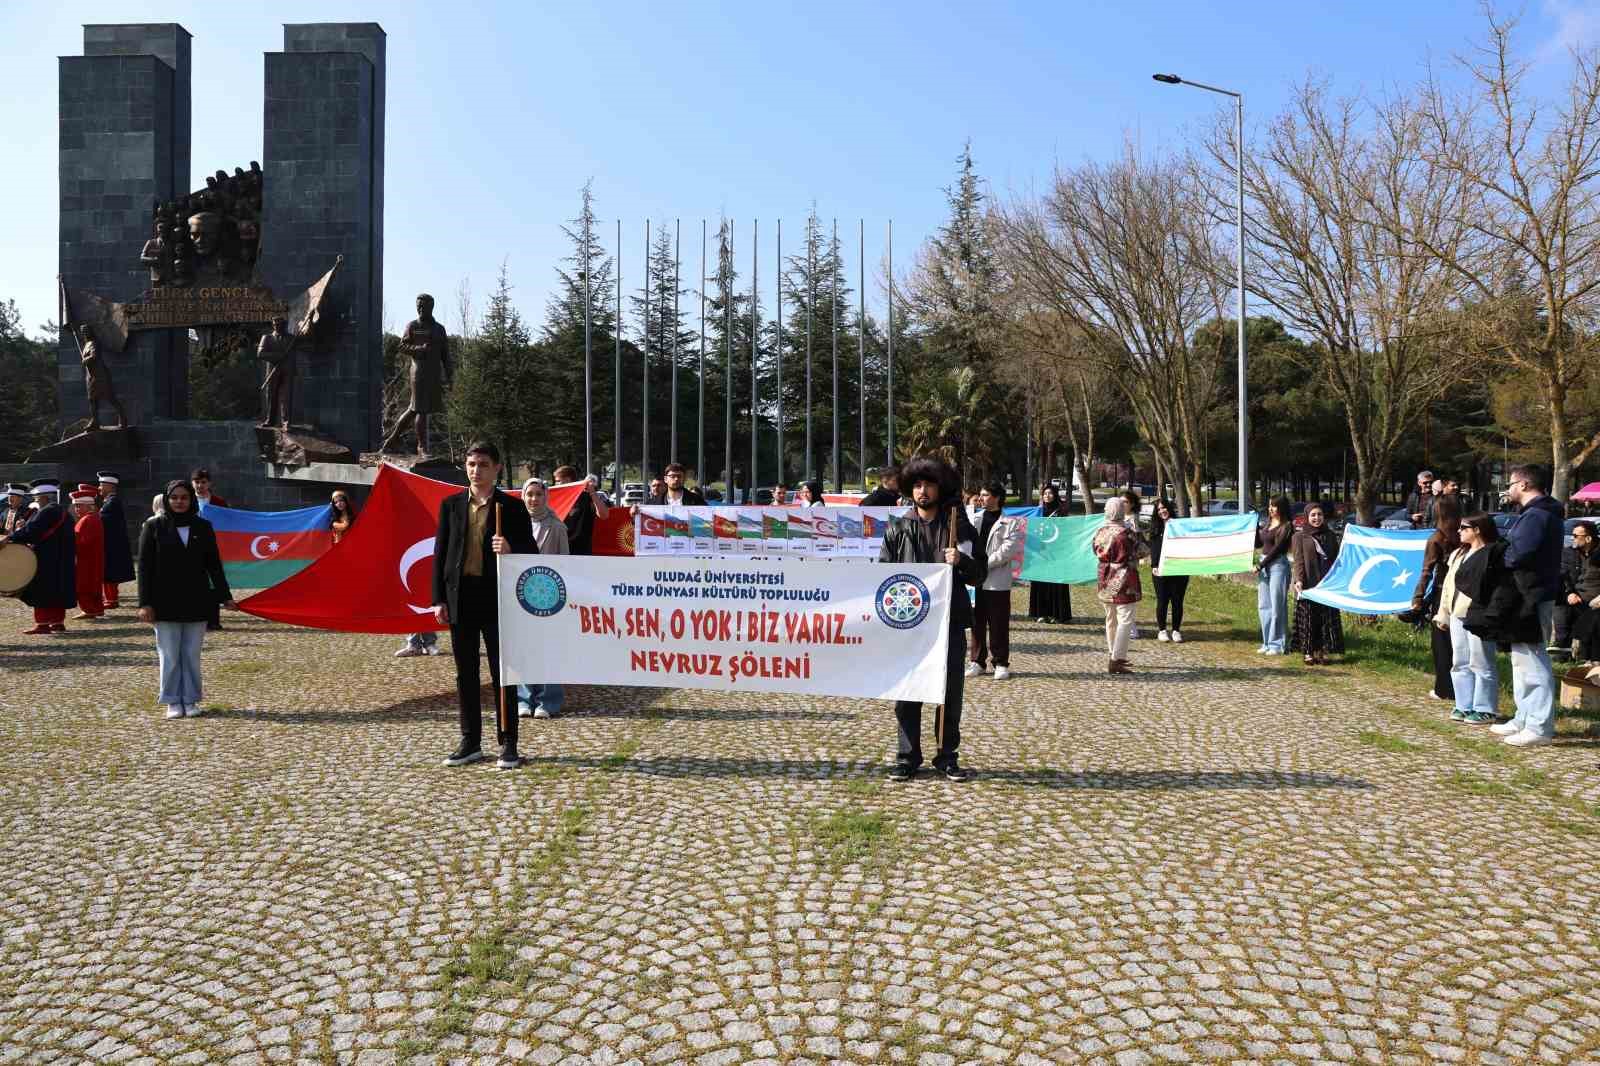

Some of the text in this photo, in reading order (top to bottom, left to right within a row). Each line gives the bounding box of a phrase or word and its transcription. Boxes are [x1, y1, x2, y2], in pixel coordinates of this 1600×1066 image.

[653, 570, 785, 585] ULUDAĞ ÜNİVERSİTESİ
[611, 583, 831, 602] TÜRK DÜNYASI KÜLTÜRÜ TOPLULUĞU
[625, 607, 665, 642] SEN,
[670, 608, 685, 641] O
[747, 602, 779, 644] BİZ
[630, 650, 811, 683] NEVRUZ ŞÖLENİ
